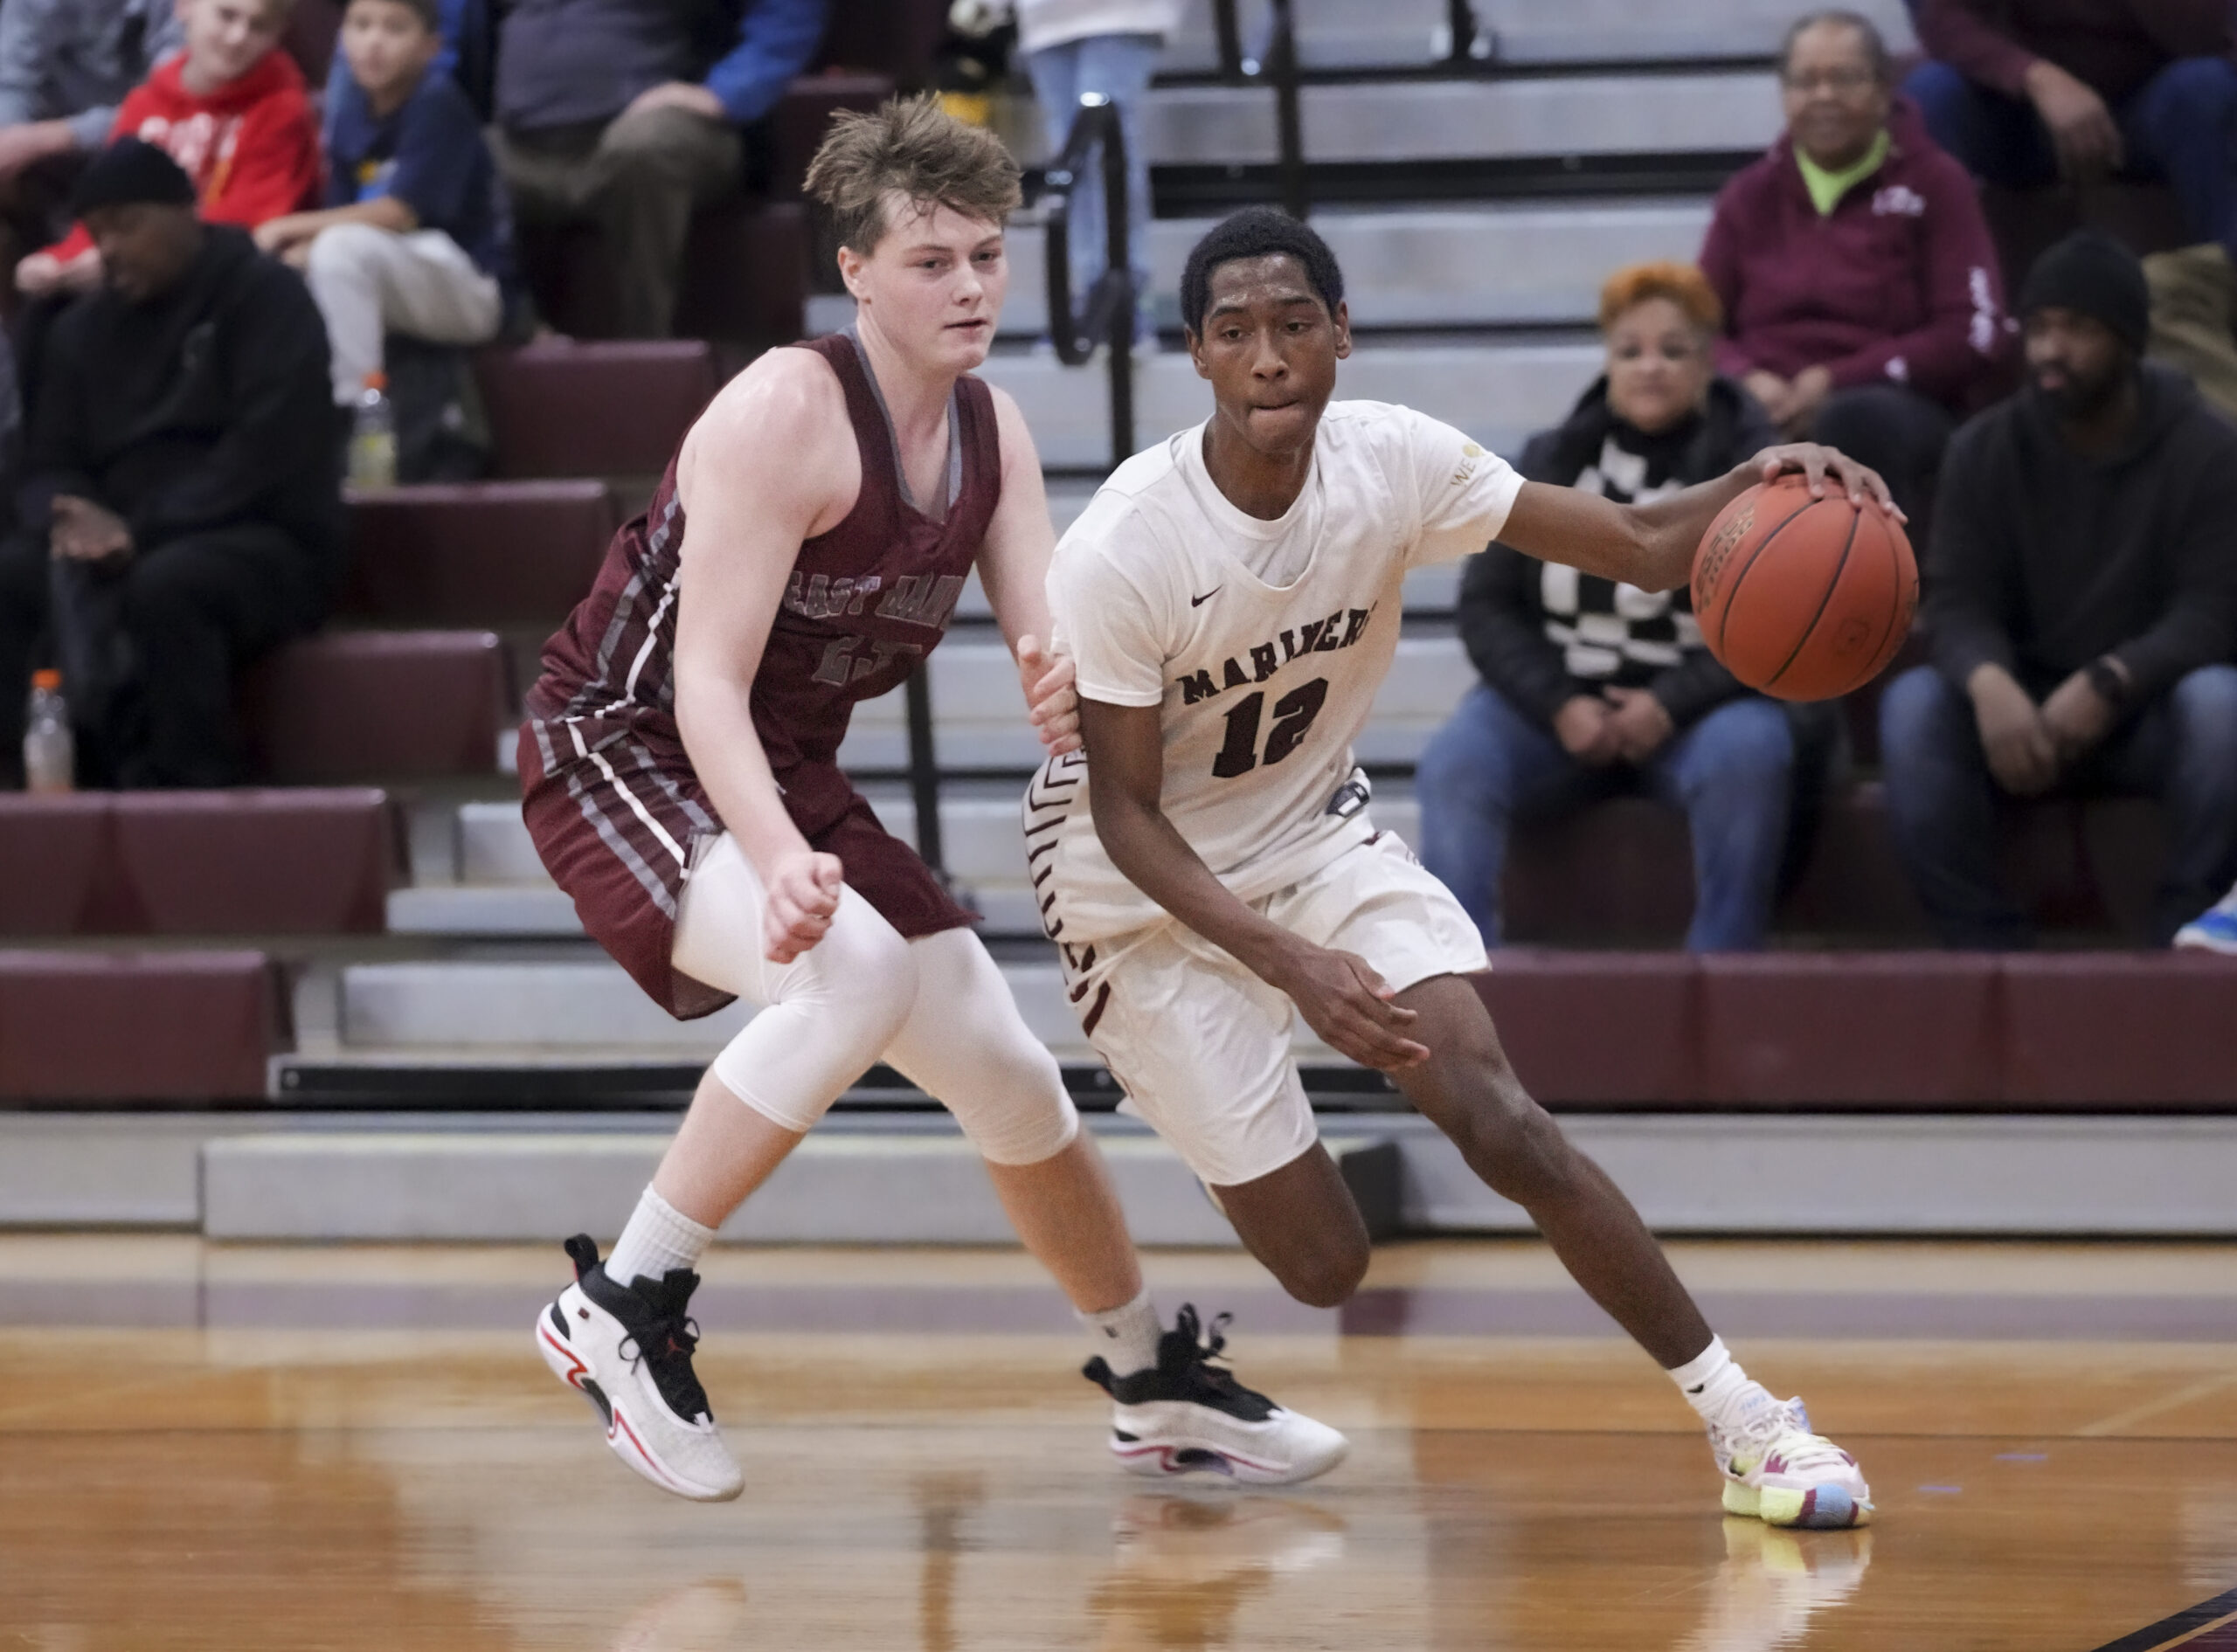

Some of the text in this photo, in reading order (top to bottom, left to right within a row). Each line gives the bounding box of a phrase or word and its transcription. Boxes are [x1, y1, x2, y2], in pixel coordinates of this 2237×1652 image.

[783, 570, 882, 619] EAST
[1175, 600, 1378, 705] MARINER
[1211, 677, 1329, 778] 12
